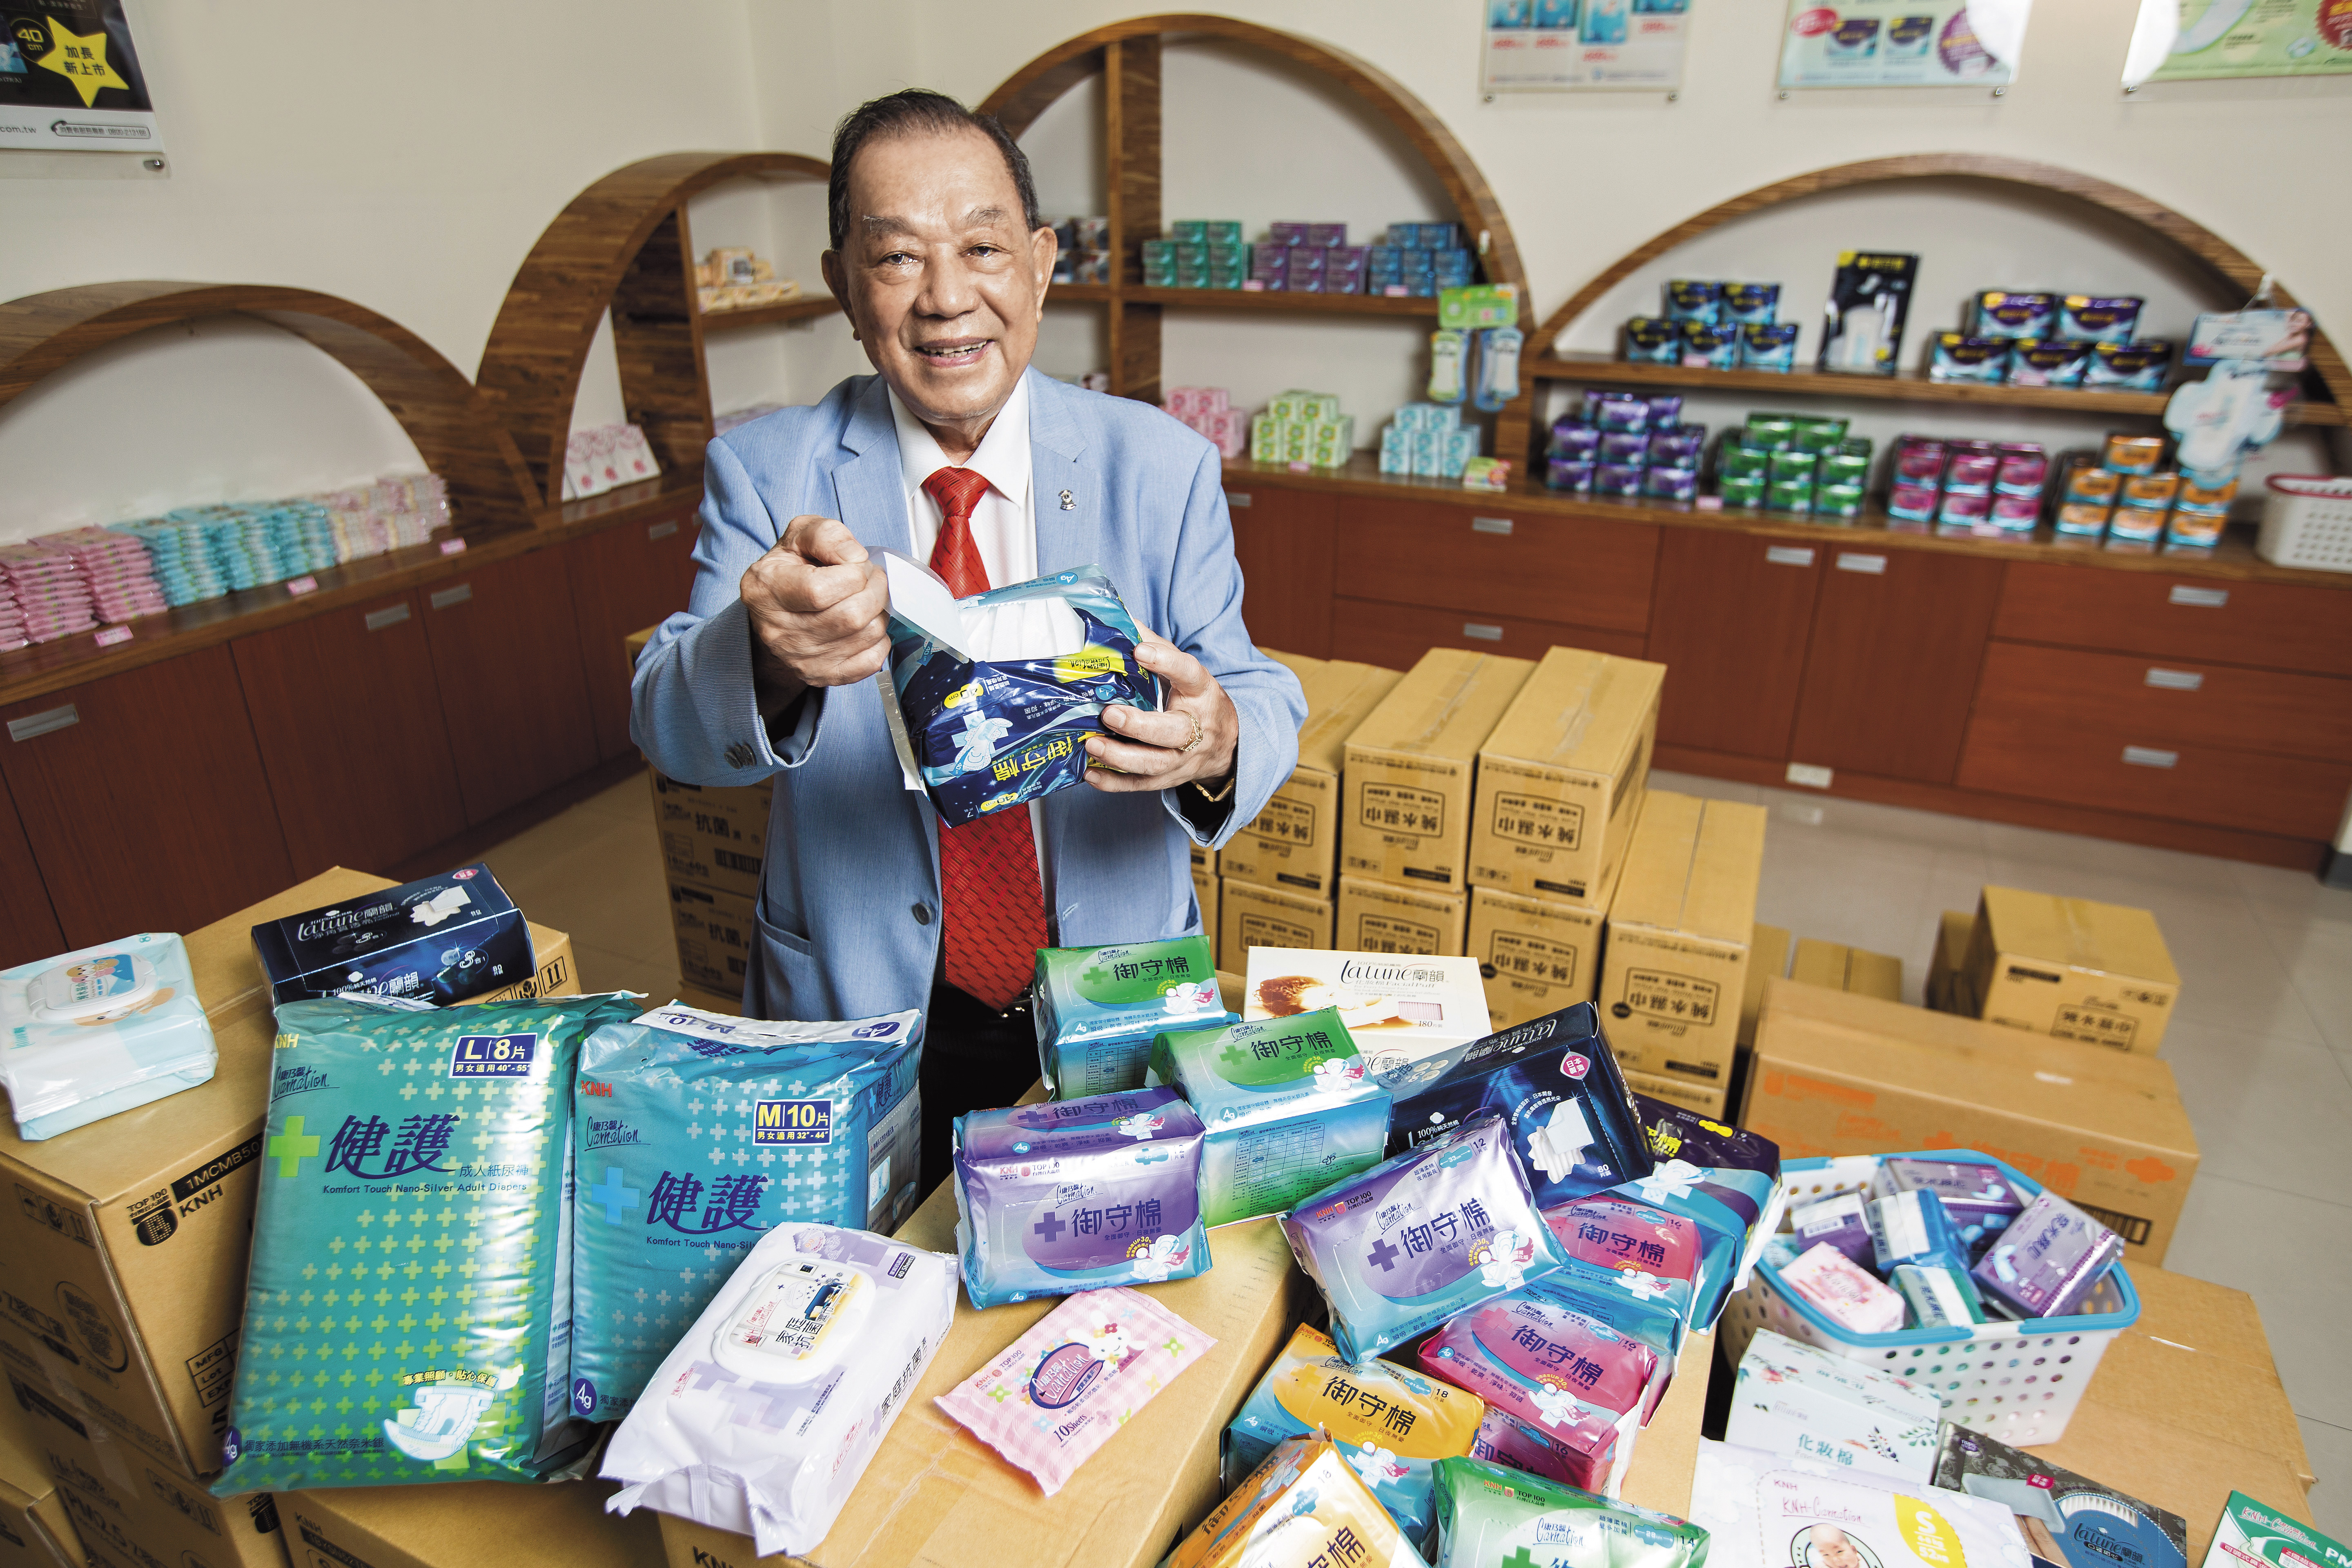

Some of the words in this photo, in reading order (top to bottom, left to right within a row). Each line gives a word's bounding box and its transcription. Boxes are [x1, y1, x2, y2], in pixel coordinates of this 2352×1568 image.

[18, 29, 44, 42] 40
[65, 45, 95, 60] 加長
[64, 62, 106, 76] 新上市
[992, 736, 1073, 782] 御守棉
[997, 794, 1013, 804] 40
[1098, 950, 1130, 962] Carnation
[1113, 956, 1189, 981] 御守棉
[1075, 1023, 1087, 1033] Ag
[1231, 1025, 1265, 1041] Carnation
[464, 1040, 483, 1060] L
[1251, 1031, 1334, 1061] 御守棉
[454, 1064, 495, 1073] 男女適用
[1566, 1057, 1581, 1068] 日本
[274, 1067, 328, 1096] Carnation
[580, 1080, 613, 1098] KNH
[758, 1105, 782, 1128] M
[1052, 1098, 1139, 1119] 御守棉
[1223, 1110, 1235, 1119] Ag
[586, 1116, 639, 1145] Carnation
[757, 1131, 795, 1141] 男女適用
[325, 1113, 461, 1180] 健護
[1014, 1143, 1028, 1152] Ag
[1472, 1138, 1486, 1149] 12
[459, 1164, 529, 1178] 成人紙尿褲
[1000, 1166, 1018, 1174] KNH
[1414, 1163, 1435, 1176] 超薄柔棉
[1416, 1168, 1438, 1181] 夜用加長
[1597, 1163, 1609, 1173] 80
[323, 1185, 361, 1194] Komfort
[364, 1184, 392, 1194] Touch
[396, 1183, 454, 1193] Nano-Silver
[457, 1183, 486, 1192] Adult
[490, 1182, 527, 1192] Diapers
[1056, 1183, 1096, 1205] Carnation
[126, 1194, 152, 1212] TOP
[149, 1187, 168, 1202] 100
[180, 1184, 224, 1218] KNH
[647, 1171, 770, 1235] 健護
[1315, 1206, 1334, 1219] KNH
[1346, 1196, 1360, 1207] TOP
[1360, 1190, 1372, 1200] 100
[1071, 1198, 1162, 1237] 御守棉
[1376, 1203, 1415, 1228] Carnation
[1570, 1205, 1608, 1221] Carnation
[1400, 1197, 1490, 1259] 御守棉
[1670, 1218, 1682, 1227] 16
[646, 1236, 681, 1247] Komfort
[684, 1238, 710, 1249] Touch
[1578, 1222, 1666, 1264] 御守棉
[898, 1270, 905, 1278] 40
[902, 1256, 915, 1272] Sheets
[1011, 1293, 1025, 1301] Ag
[1516, 1301, 1554, 1328] Carnation
[775, 1317, 808, 1345] 家庭
[1375, 1334, 1389, 1345] Ag
[1439, 1347, 1452, 1357] Ag
[1624, 1339, 1637, 1350] 16
[195, 1347, 223, 1368] MFG
[999, 1356, 1012, 1368] TOP
[1009, 1349, 1022, 1361] 100
[1512, 1324, 1605, 1387] 御守棉
[202, 1367, 223, 1384] Lot
[207, 1378, 232, 1400] EXP
[575, 1386, 594, 1410] Ag
[1435, 1388, 1449, 1398] 18
[1323, 1375, 1417, 1436] 御守棉
[1053, 1424, 1070, 1443] 10
[1068, 1413, 1088, 1433] Sheets
[1245, 1415, 1259, 1425] Ag
[1555, 1443, 1569, 1455] 16
[1798, 1433, 1853, 1465] 化妝棉
[1483, 1479, 1502, 1491] KNH
[1517, 1490, 1532, 1498] TOP
[1532, 1493, 1545, 1503] 100
[1774, 1479, 1798, 1490] KNH
[1537, 1517, 1584, 1546] Carnation
[1545, 1523, 1566, 1533] 康乃馨
[1599, 1522, 1627, 1535] 量多加長
[1599, 1515, 1627, 1528] 超薄柔棉
[1680, 1536, 1695, 1548] 14
[1915, 1511, 1937, 1535] S
